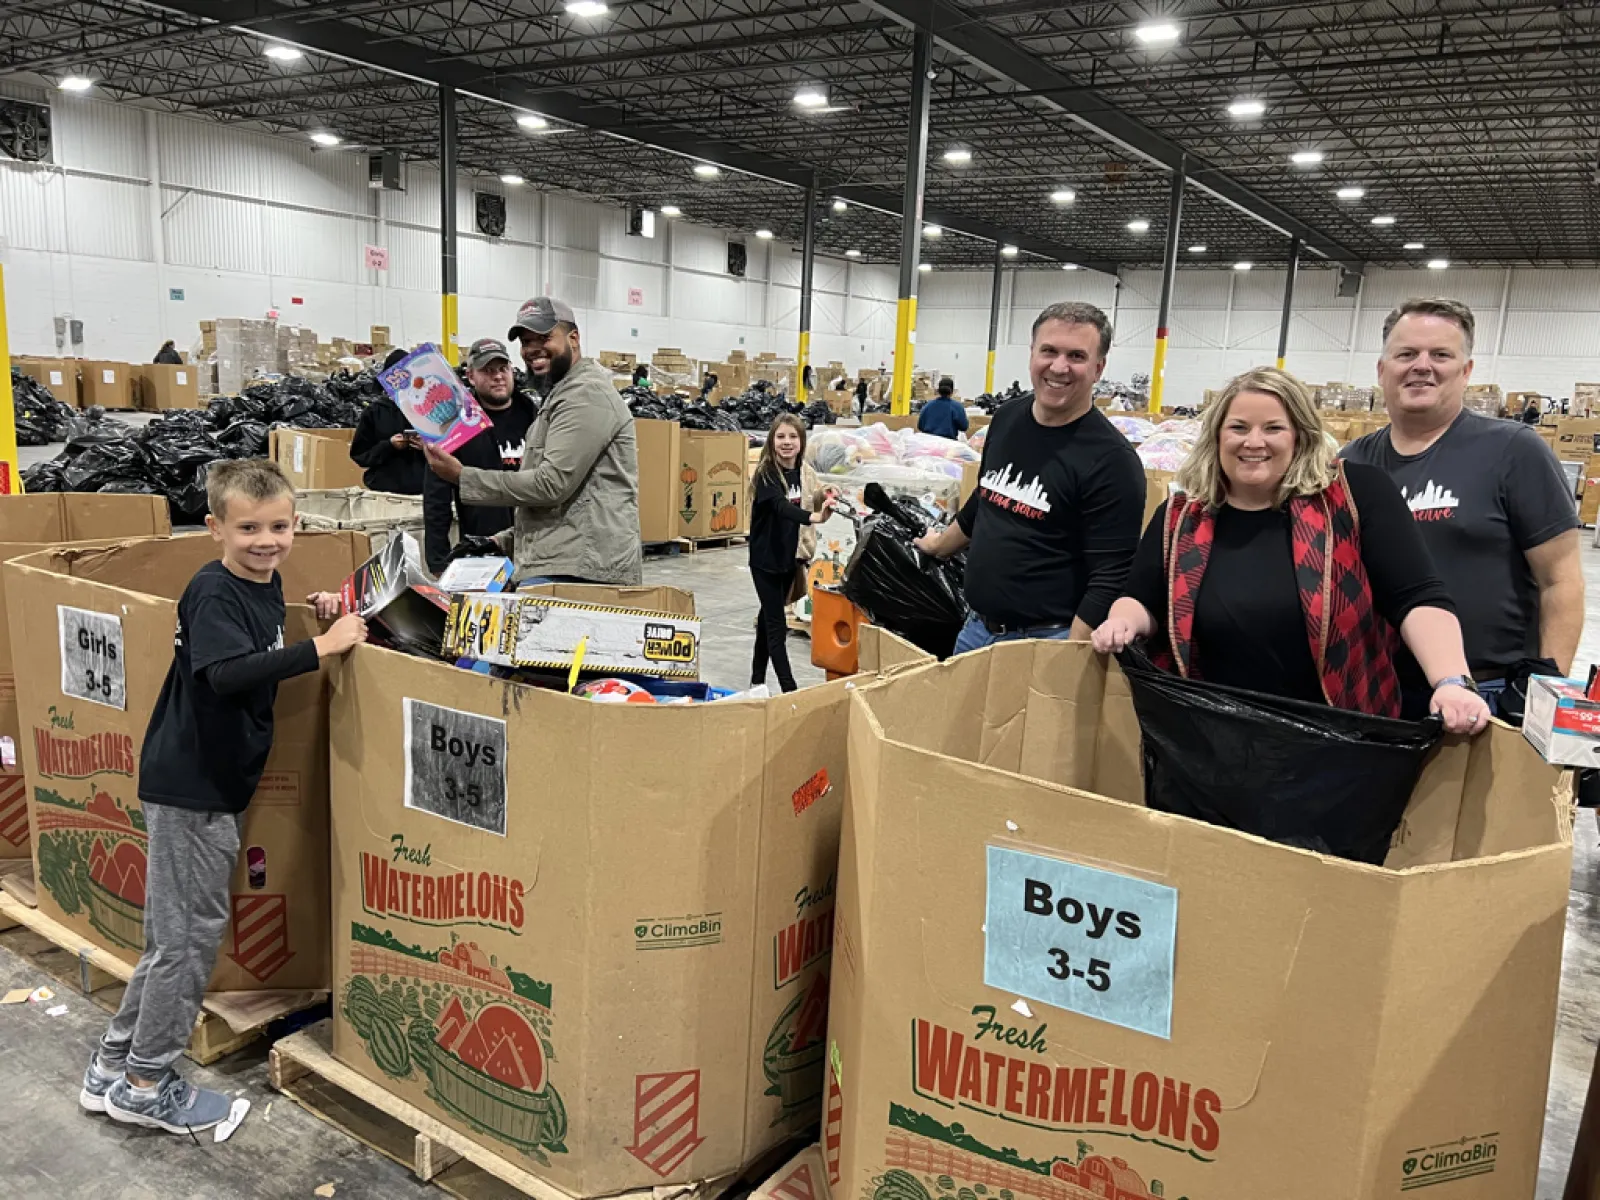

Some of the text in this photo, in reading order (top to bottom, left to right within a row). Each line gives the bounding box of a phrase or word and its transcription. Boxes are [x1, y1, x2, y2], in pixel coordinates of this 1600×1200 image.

[78, 628, 117, 660] Girls
[647, 640, 691, 657] POWER
[86, 669, 111, 697] 3-5
[48, 705, 74, 740] Fresh
[35, 727, 134, 775] WATERMELONS
[431, 724, 496, 767] Boys
[445, 777, 481, 807] 3-5
[390, 834, 431, 867] Fresh
[363, 851, 524, 929] WATERMELONS
[794, 873, 833, 919] Fresh
[1024, 877, 1142, 940] Boys
[651, 919, 721, 938] ClimaBin
[1047, 947, 1111, 992] 3-5
[971, 1005, 1048, 1054] Fresh
[917, 1017, 1222, 1152] WATERMELONS
[1420, 1142, 1497, 1171] ClimaBin
